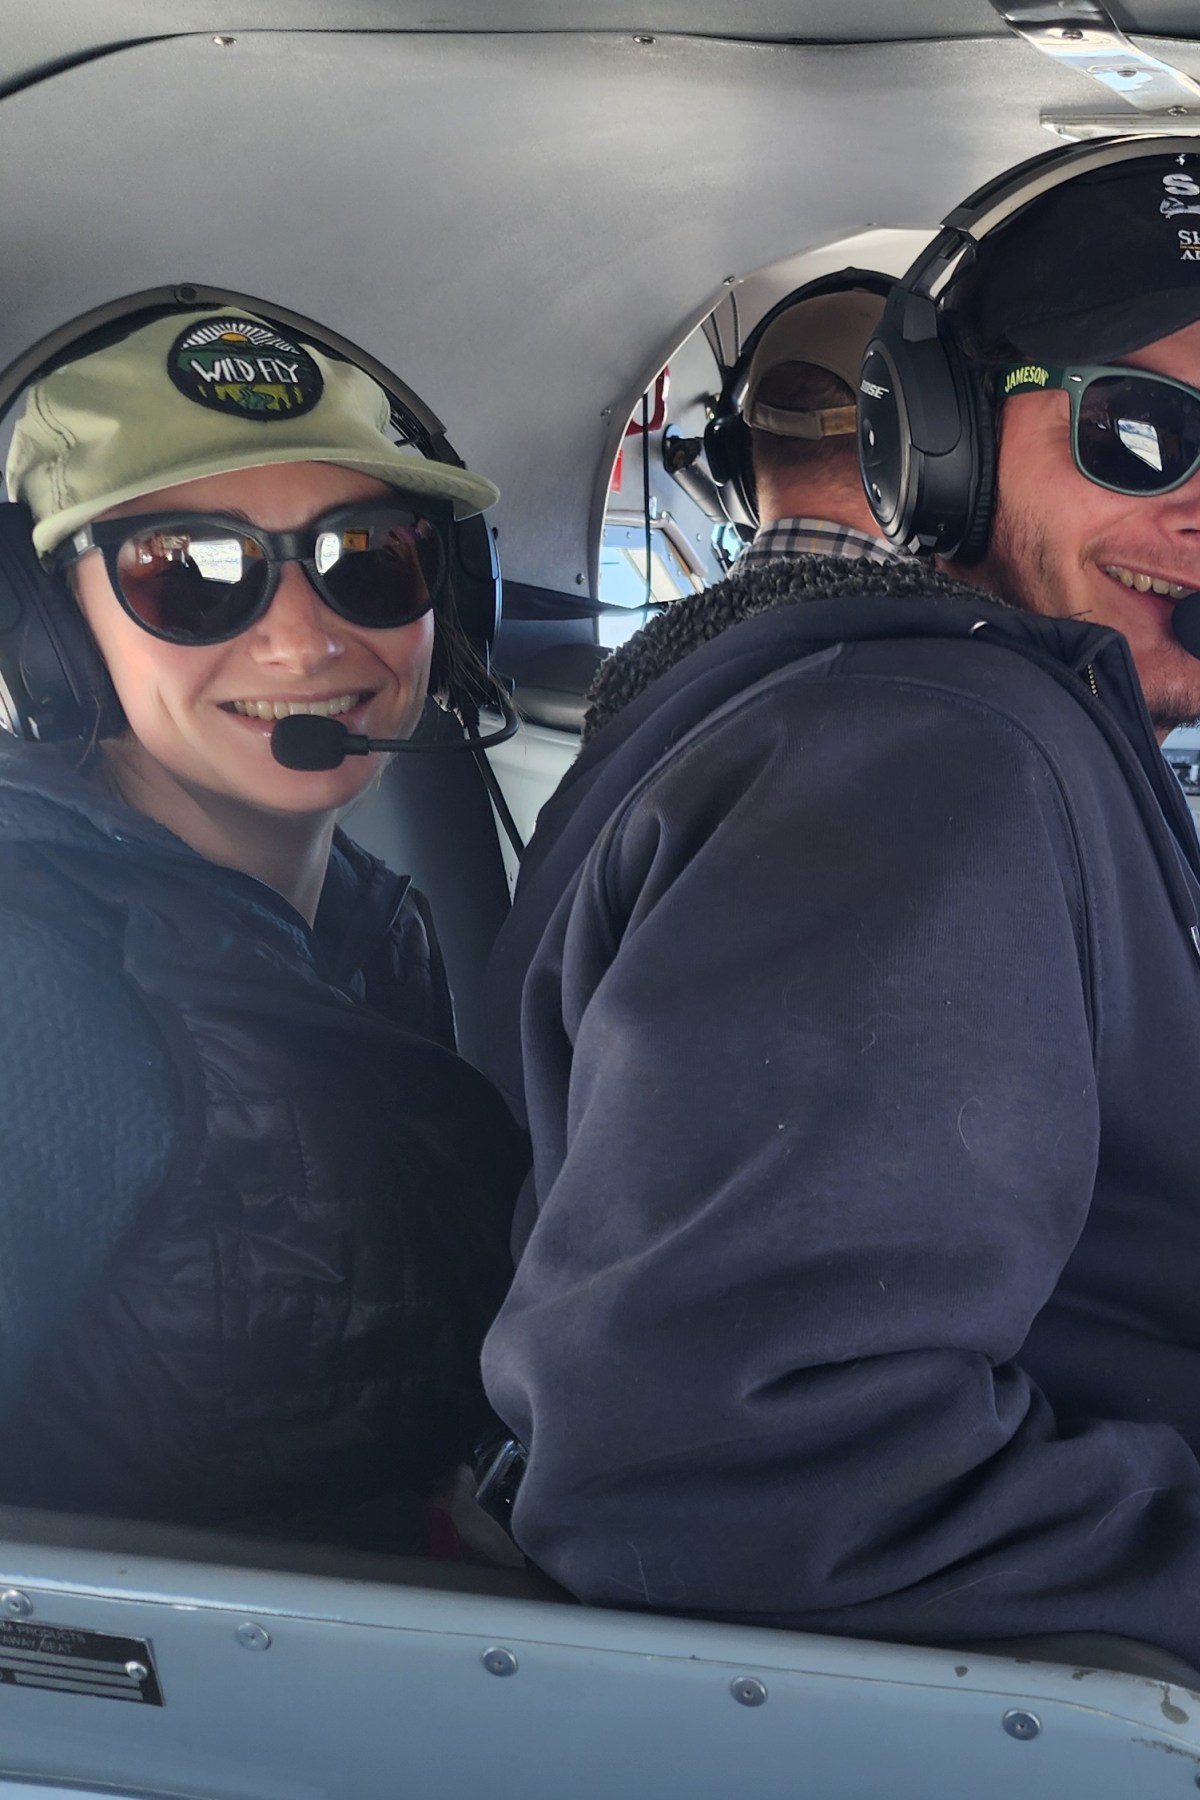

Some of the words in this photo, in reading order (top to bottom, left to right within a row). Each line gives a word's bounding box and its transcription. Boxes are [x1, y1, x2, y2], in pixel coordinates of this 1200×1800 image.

[191, 357, 255, 383] WILD
[256, 358, 299, 383] FLY
[1004, 365, 1047, 393] JAMESON
